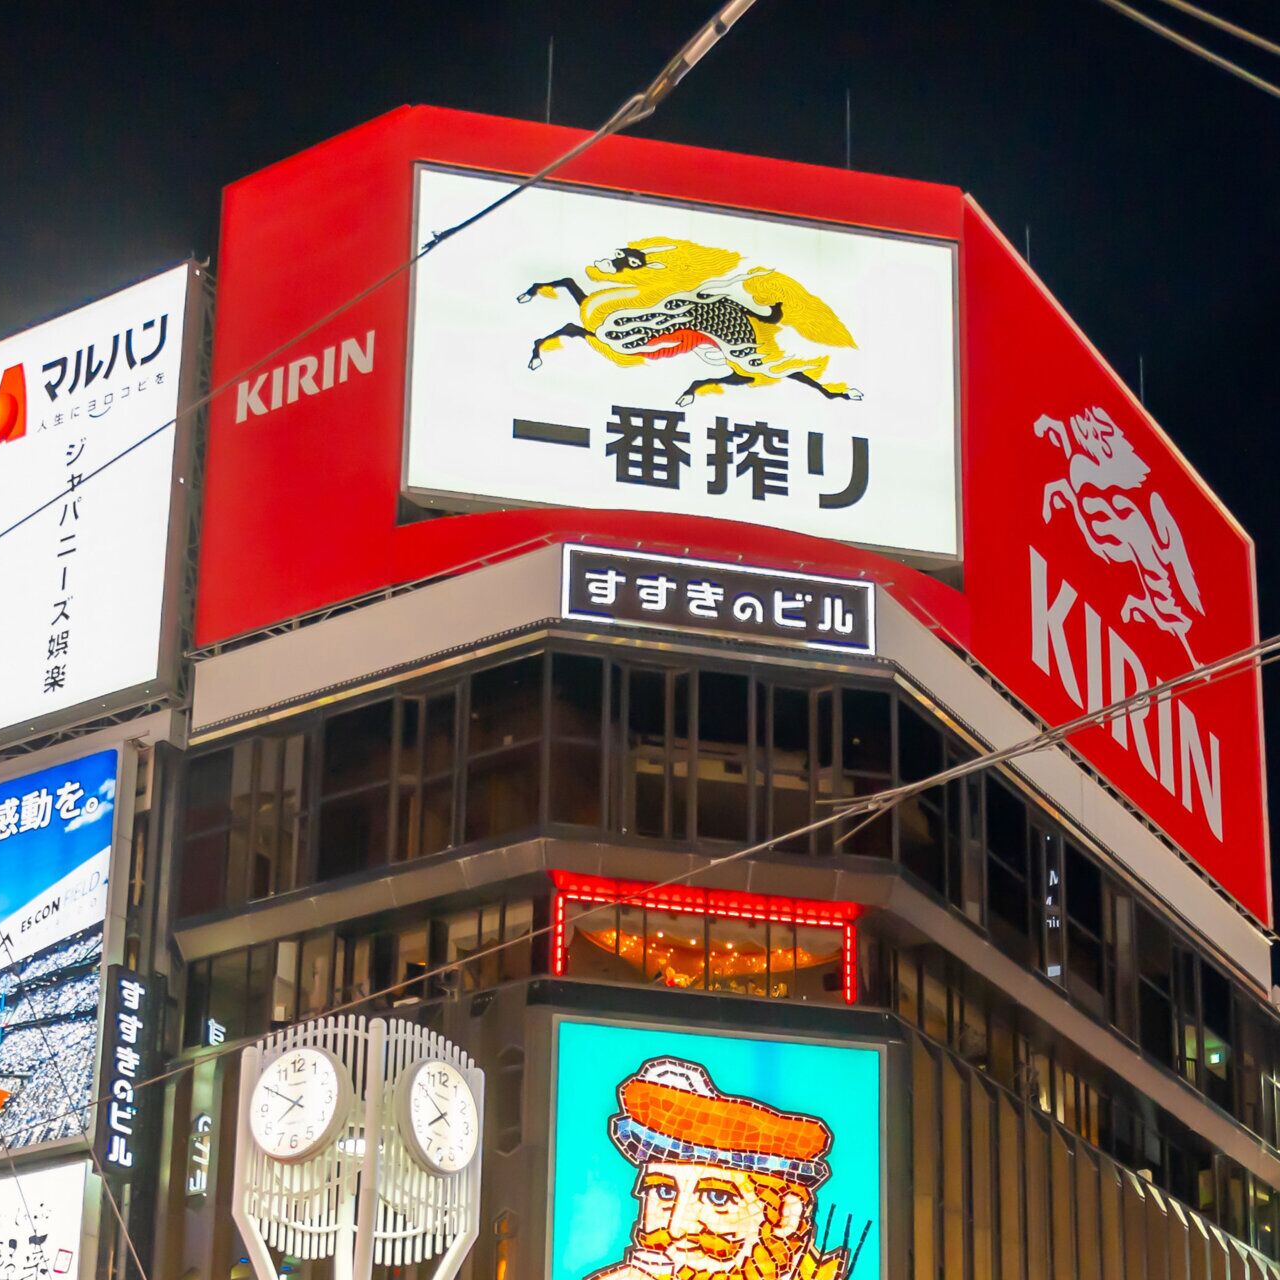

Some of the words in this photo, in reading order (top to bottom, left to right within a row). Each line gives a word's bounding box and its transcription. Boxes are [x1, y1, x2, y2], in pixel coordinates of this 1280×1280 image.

[42, 314, 169, 400] マルハン
[235, 330, 377, 424] KIRIN
[36, 372, 165, 432] 人生にヨロコビを
[512, 405, 870, 510] 一番搾り
[43, 437, 85, 695] ジャパニーズ娯楽
[585, 567, 855, 636] すすきのビル
[1028, 546, 1223, 842] KIRIN
[109, 980, 145, 1167] すすきのビル
[277, 1067, 288, 1081] 11
[291, 1057, 305, 1073] 12
[312, 1061, 318, 1075] 1
[325, 1091, 333, 1105] 3
[290, 1135, 298, 1149] 6
